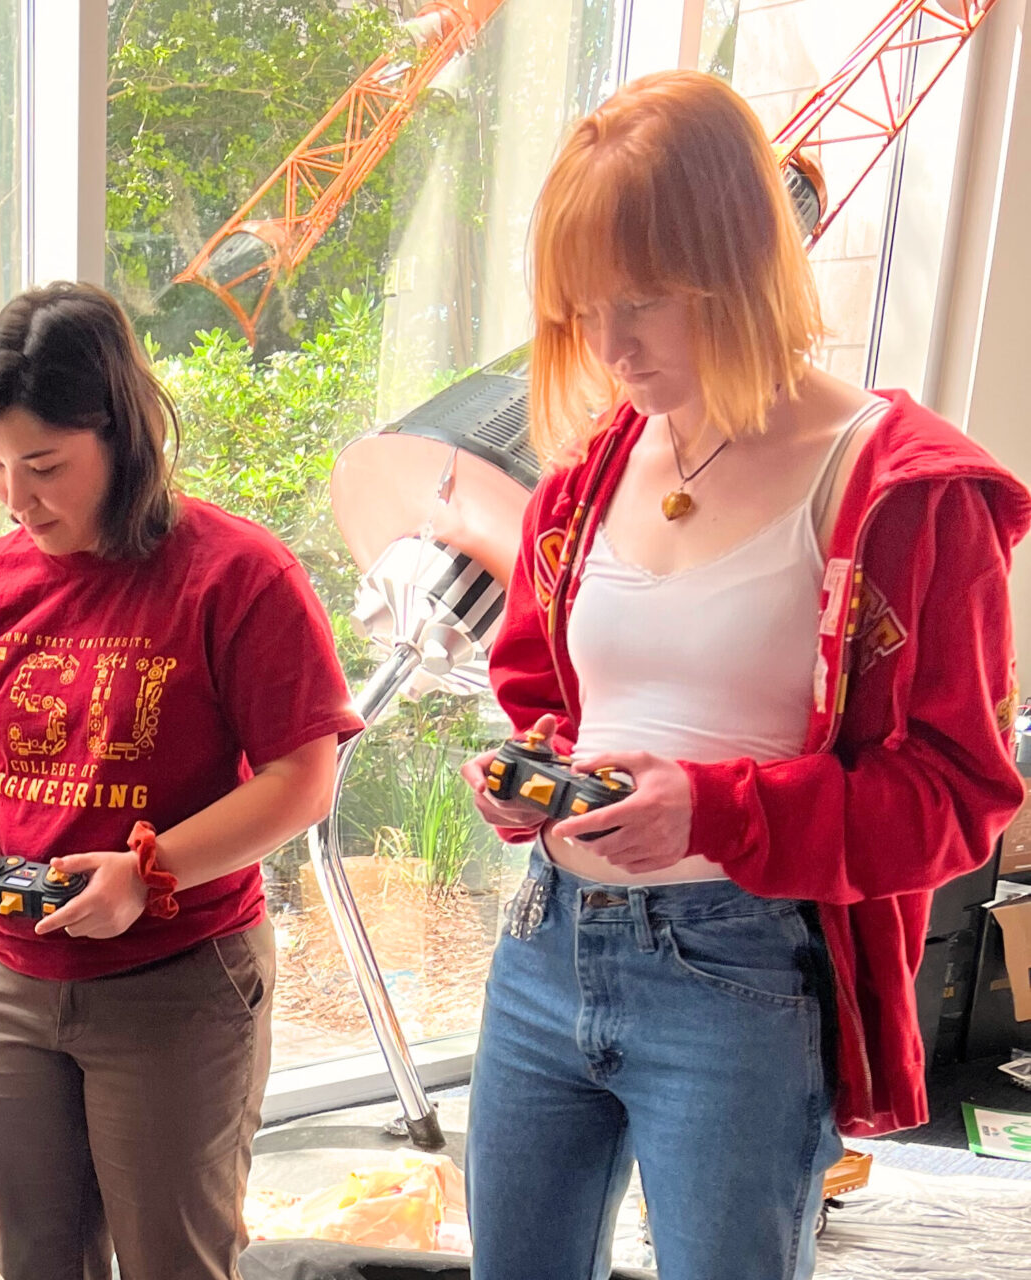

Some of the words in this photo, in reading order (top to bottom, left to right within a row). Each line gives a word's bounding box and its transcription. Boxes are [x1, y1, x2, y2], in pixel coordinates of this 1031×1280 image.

[35, 635, 73, 649] STATE
[10, 760, 76, 777] COLLEGE
[80, 764, 98, 778] OF
